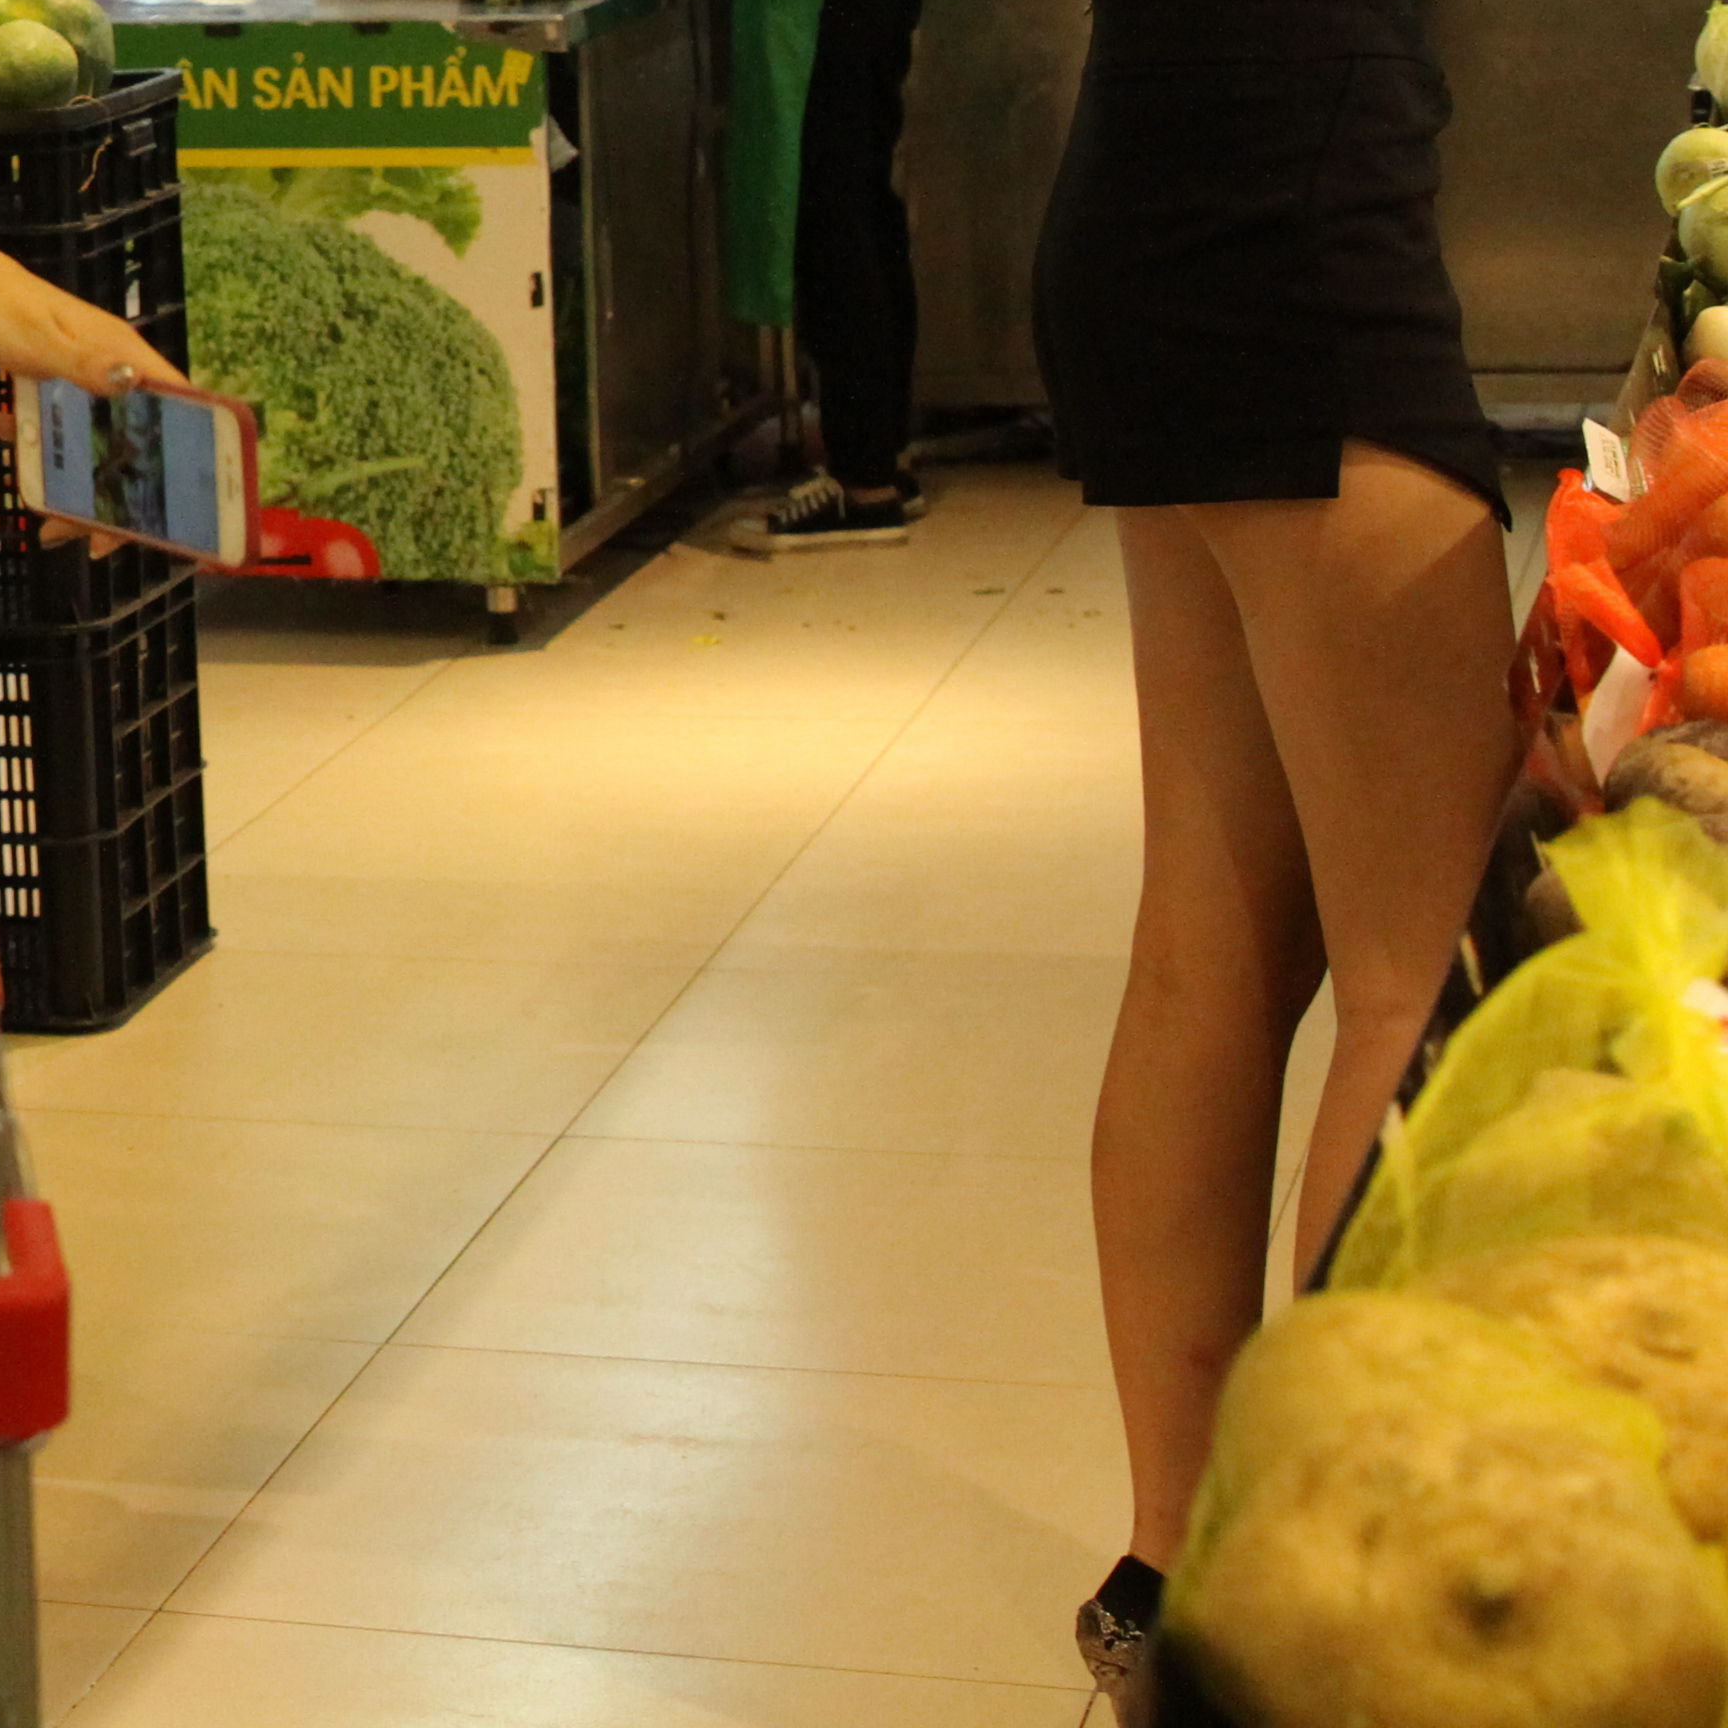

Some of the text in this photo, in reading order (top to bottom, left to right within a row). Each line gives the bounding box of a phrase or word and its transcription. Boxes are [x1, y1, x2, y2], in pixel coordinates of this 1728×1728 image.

[177, 45, 521, 110] ÂN SẢN PHẨM
